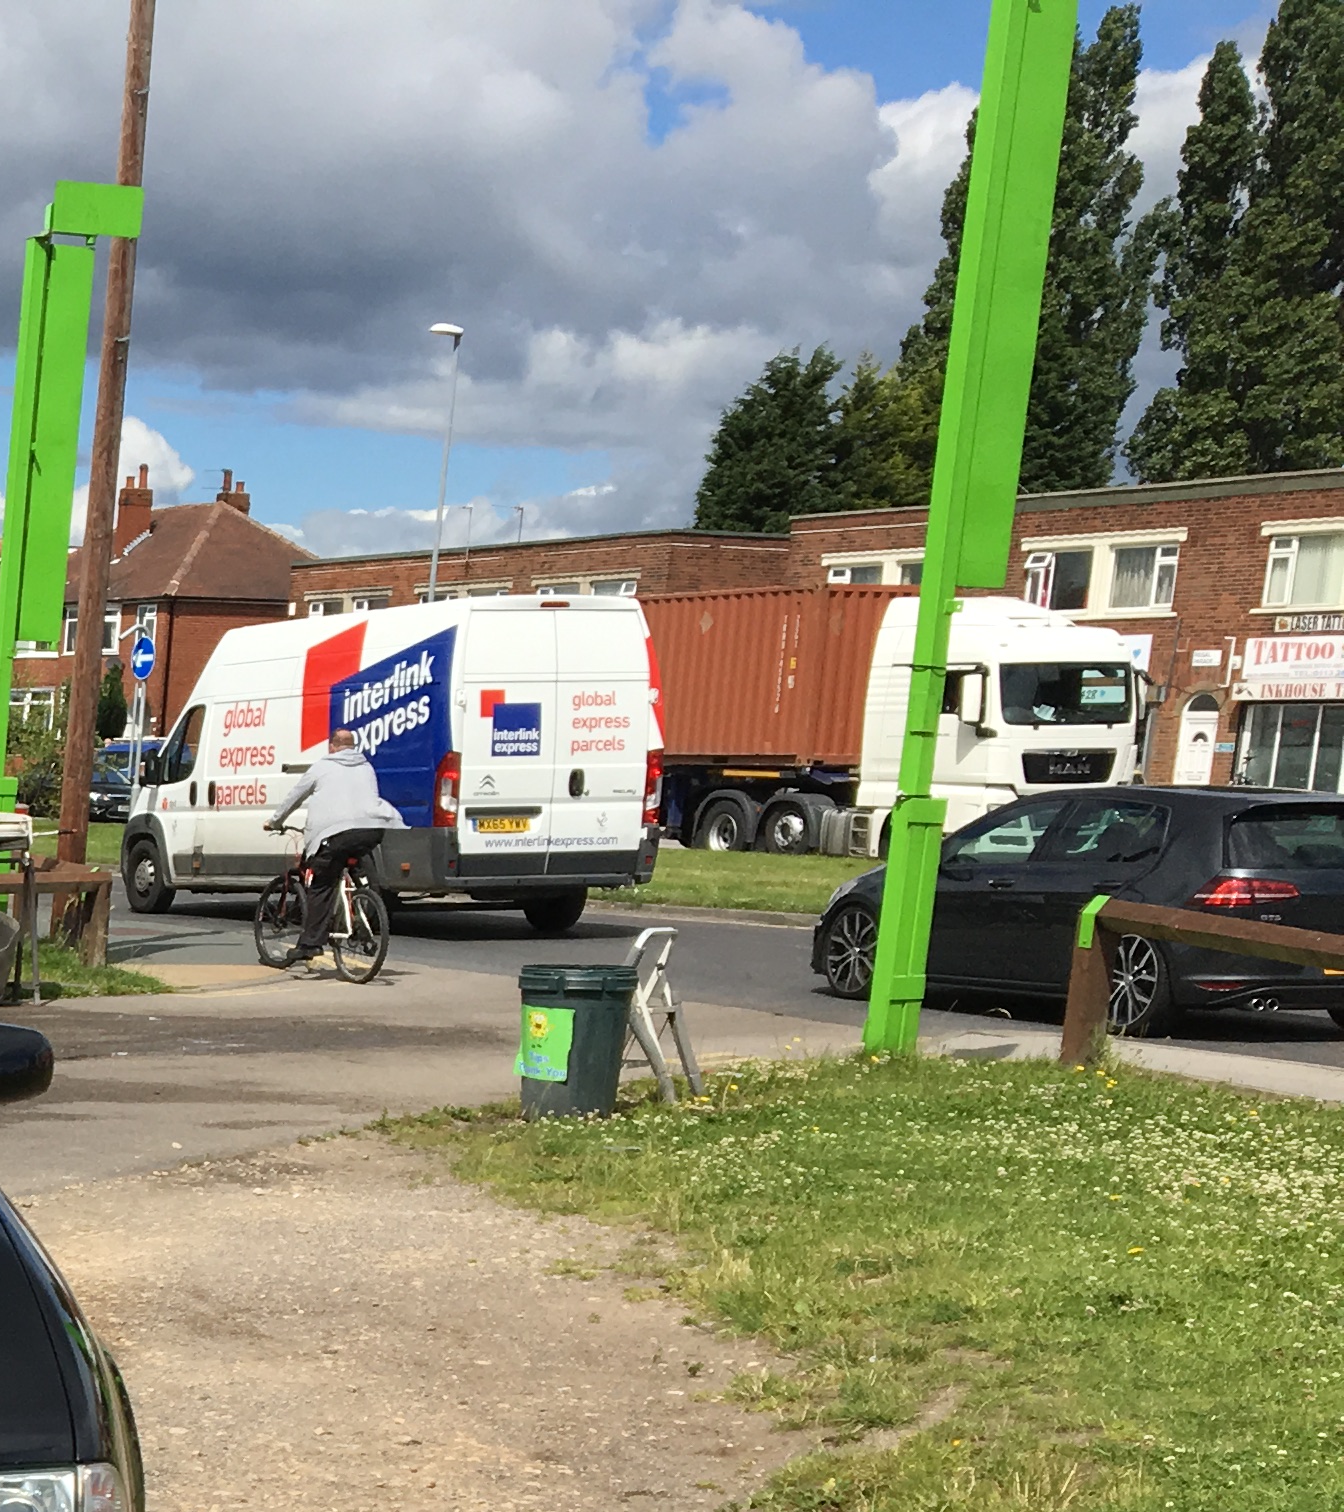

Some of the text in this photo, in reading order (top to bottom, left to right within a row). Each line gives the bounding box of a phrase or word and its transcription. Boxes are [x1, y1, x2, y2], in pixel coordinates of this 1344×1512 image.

[1254, 640, 1334, 665] TATTOO
[343, 650, 435, 724] interlink
[1261, 683, 1327, 698] INKHOUSE
[572, 691, 616, 711] global
[223, 699, 268, 737] global
[572, 716, 631, 732] express
[493, 728, 540, 741] interlink
[494, 742, 538, 754] express
[571, 736, 625, 756] parcels
[219, 744, 276, 774] express
[216, 778, 267, 811] parcels
[485, 834, 618, 849] www.interlinkexpress.com
